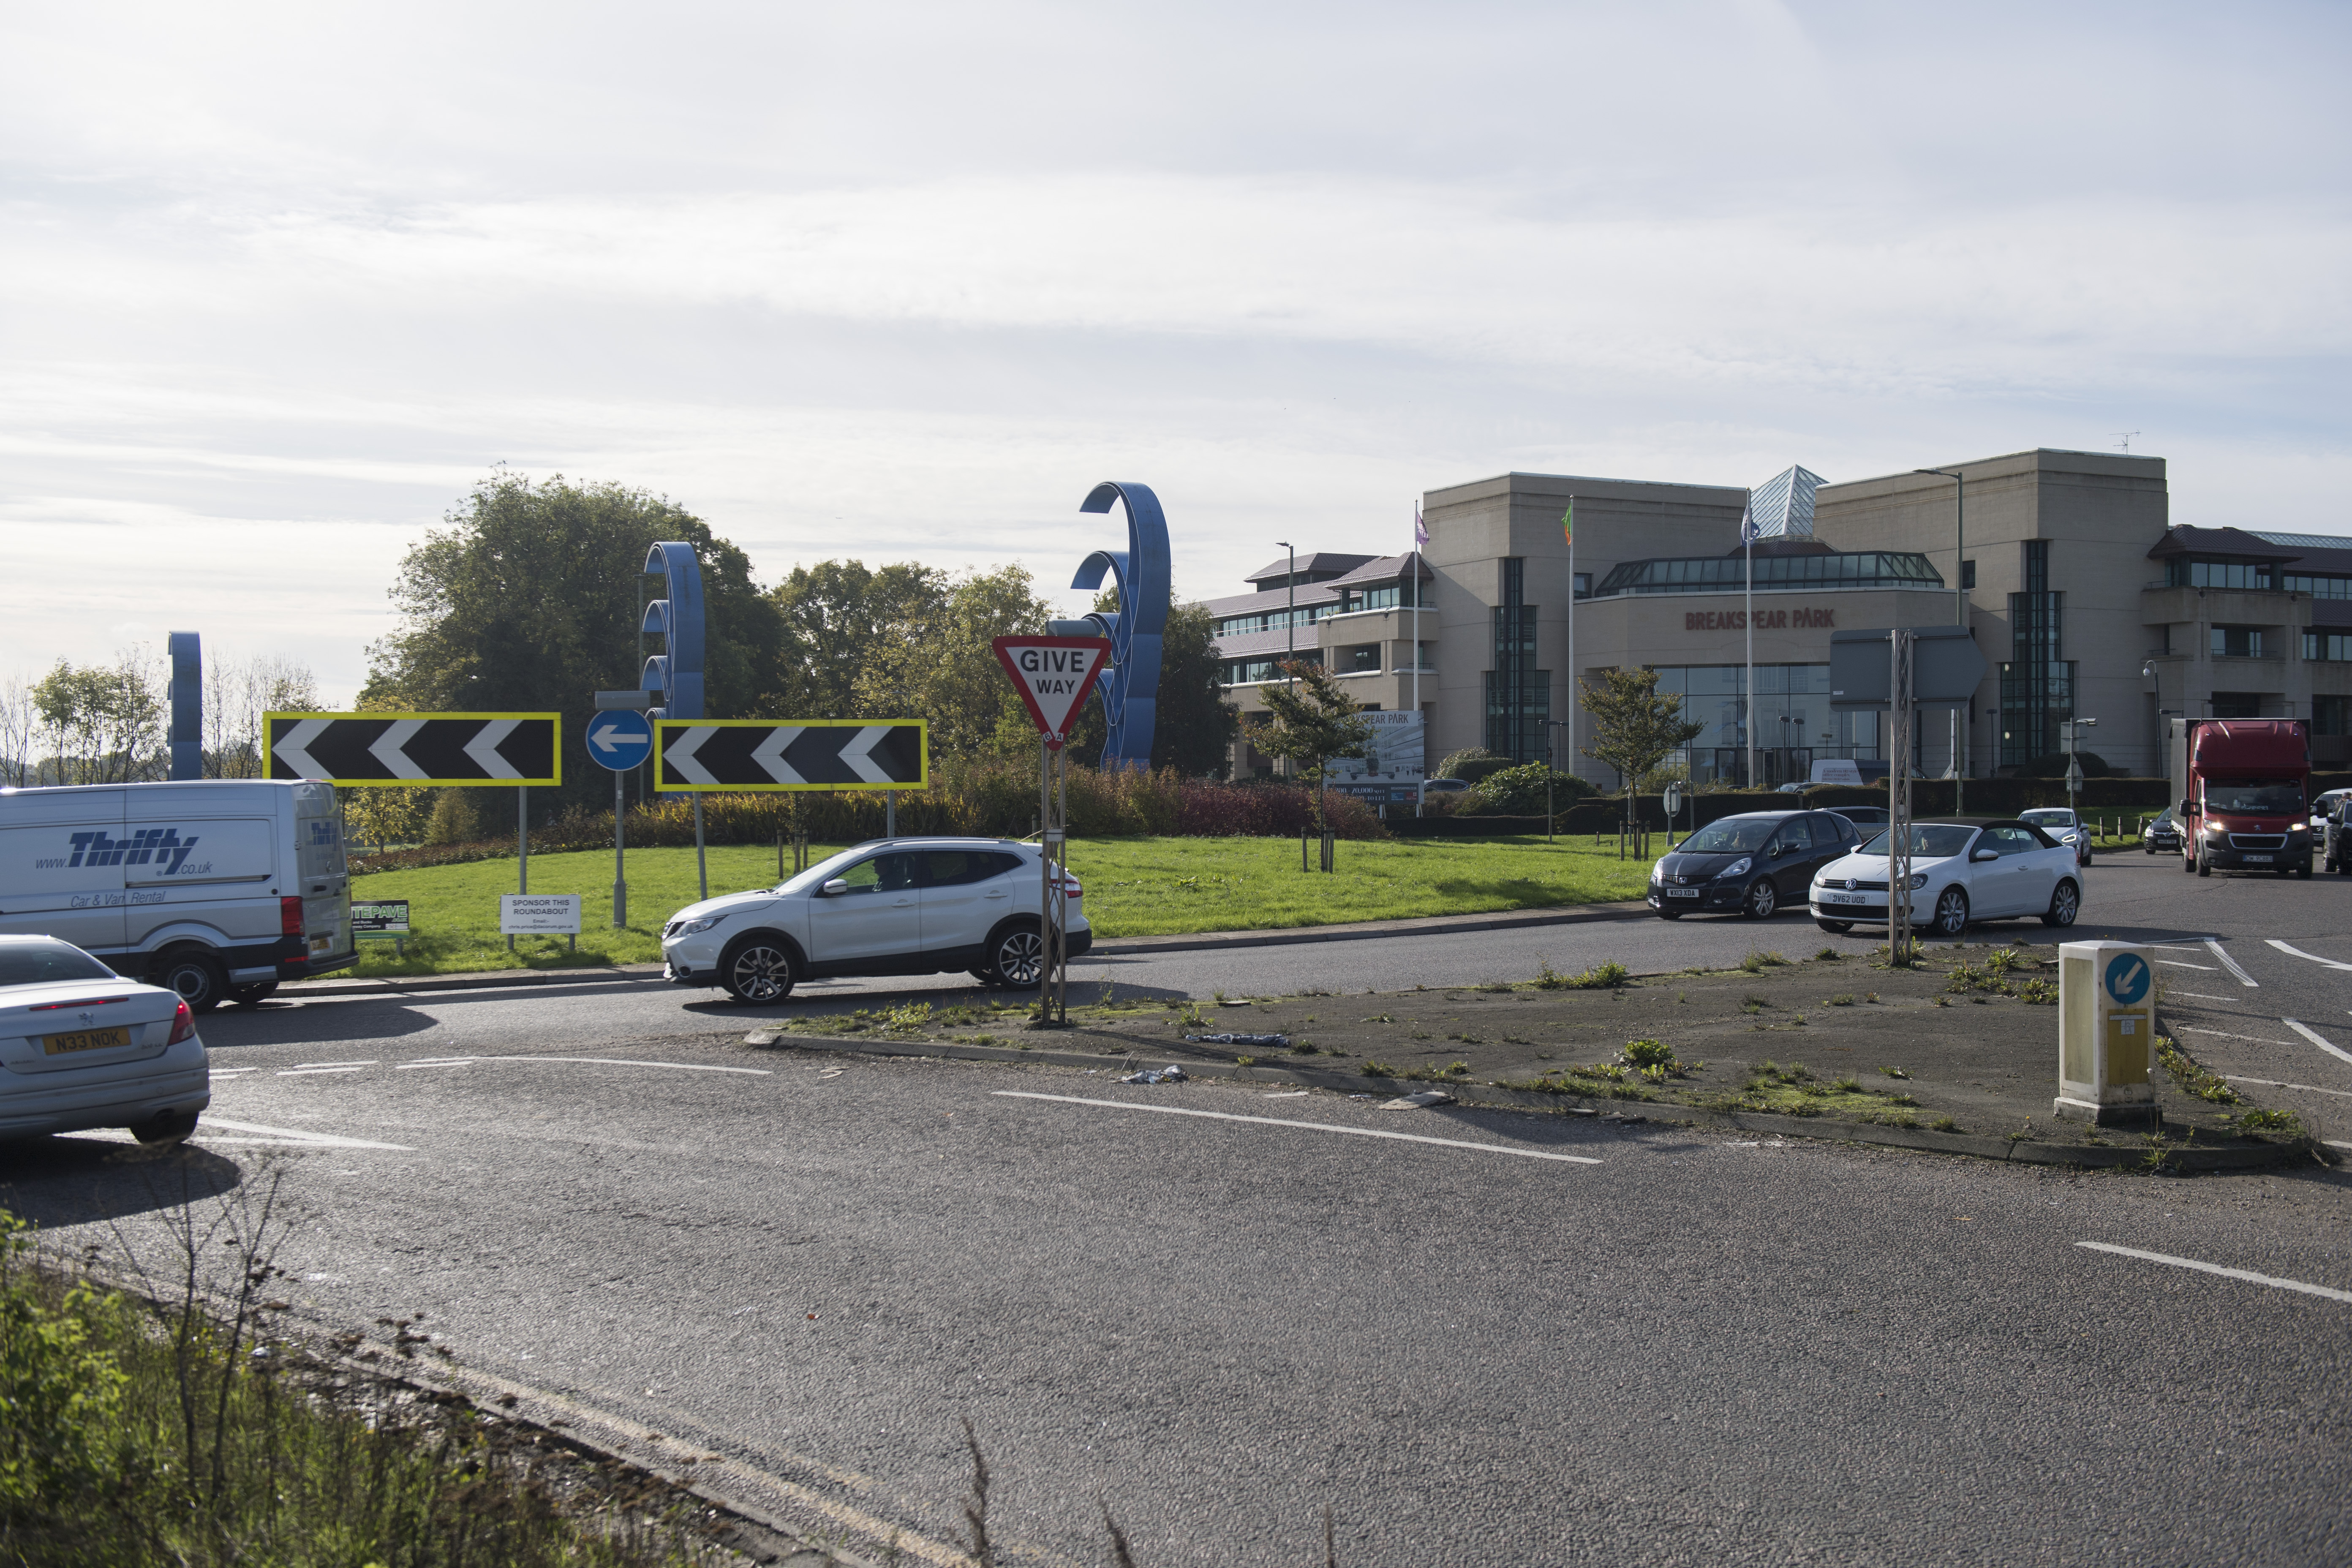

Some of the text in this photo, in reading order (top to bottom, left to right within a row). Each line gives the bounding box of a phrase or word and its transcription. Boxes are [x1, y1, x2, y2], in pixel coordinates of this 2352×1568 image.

[1685, 607, 1835, 630] BREAKSPEAR PARK
[1020, 650, 1084, 672] GIVE
[1036, 679, 1075, 694] WAY
[1388, 713, 1409, 724] PARK
[71, 891, 166, 907] Car & Van Rental
[55, 1032, 120, 1051] N33 NOK
